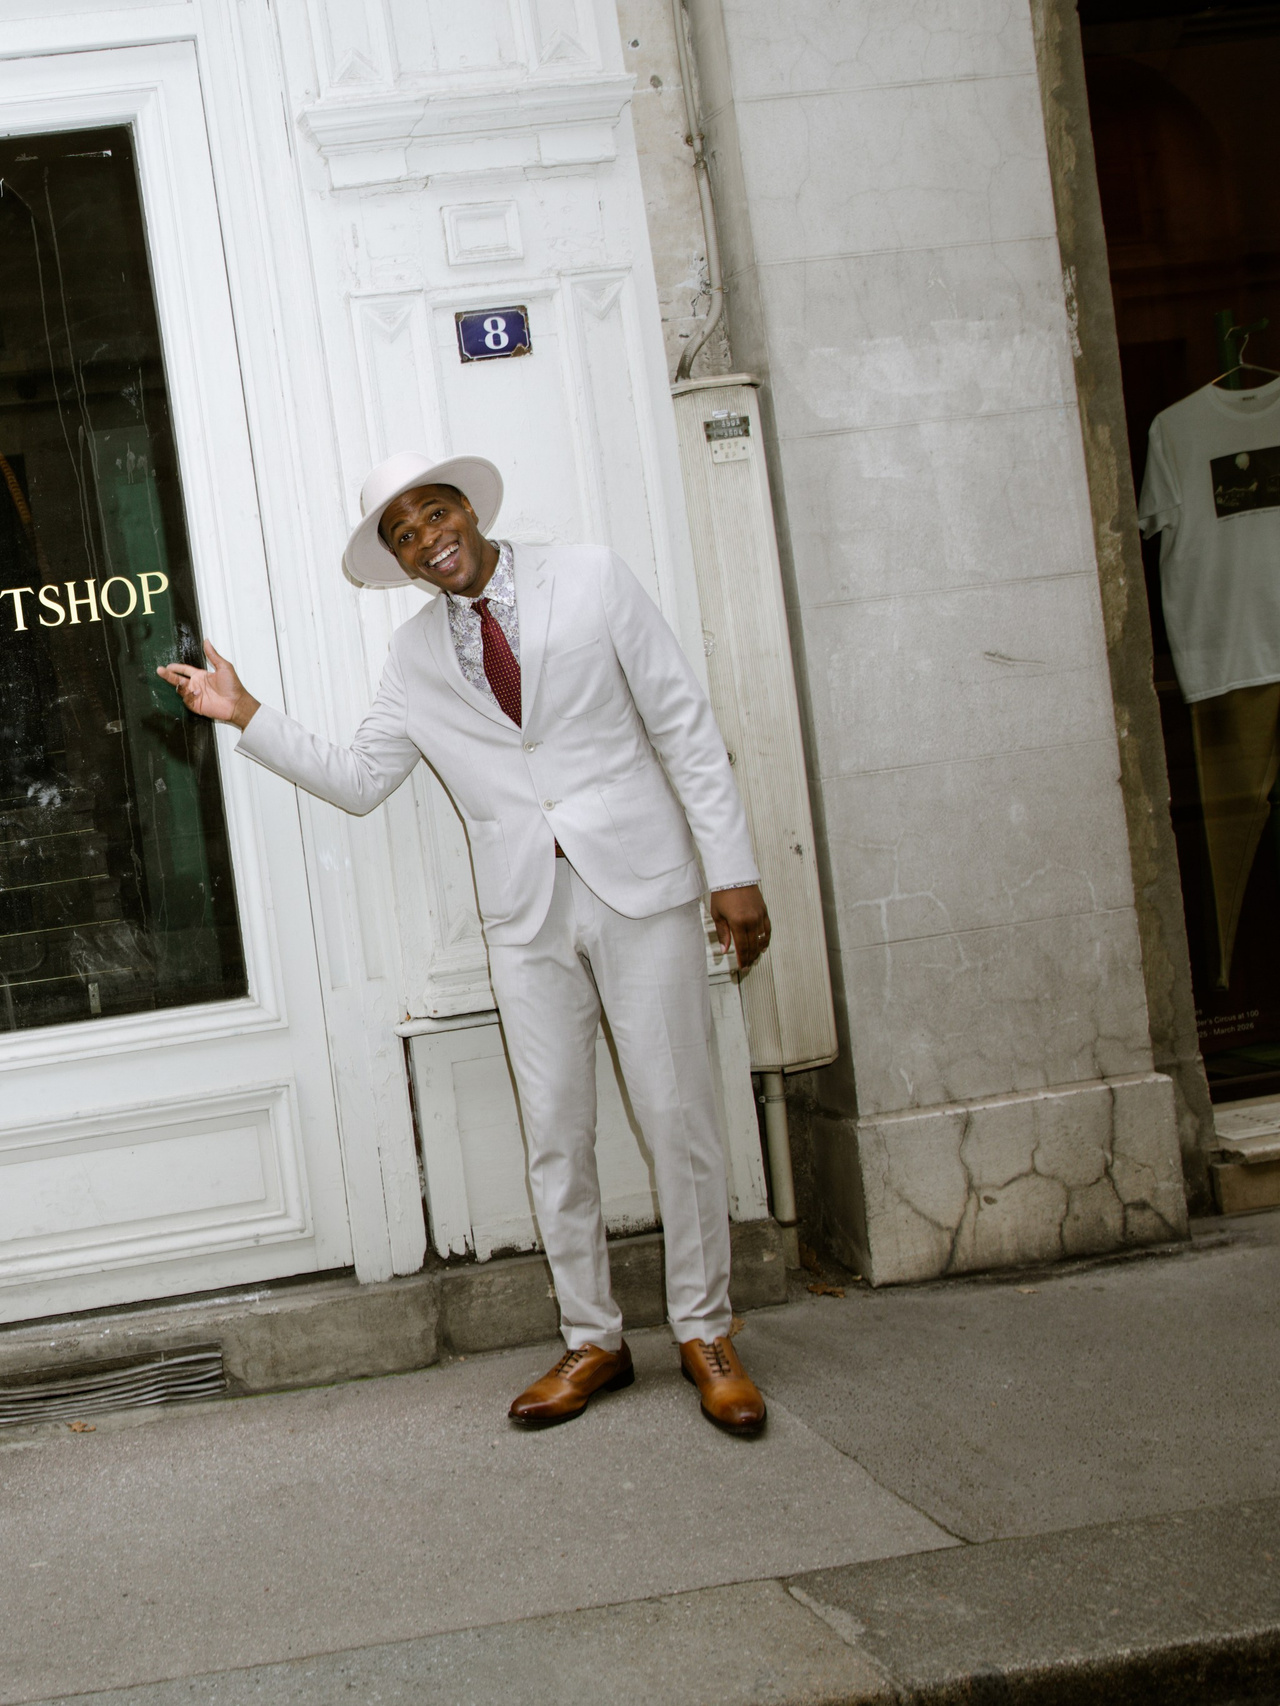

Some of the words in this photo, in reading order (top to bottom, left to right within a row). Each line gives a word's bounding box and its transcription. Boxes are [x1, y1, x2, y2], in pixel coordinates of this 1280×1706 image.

[483, 316, 509, 350] 8
[1214, 1014, 1237, 1024] Circus
[1238, 1012, 1245, 1020] at
[1246, 1009, 1260, 1018] 100
[1213, 1025, 1236, 1036] March
[1237, 1022, 1255, 1032] 2026
